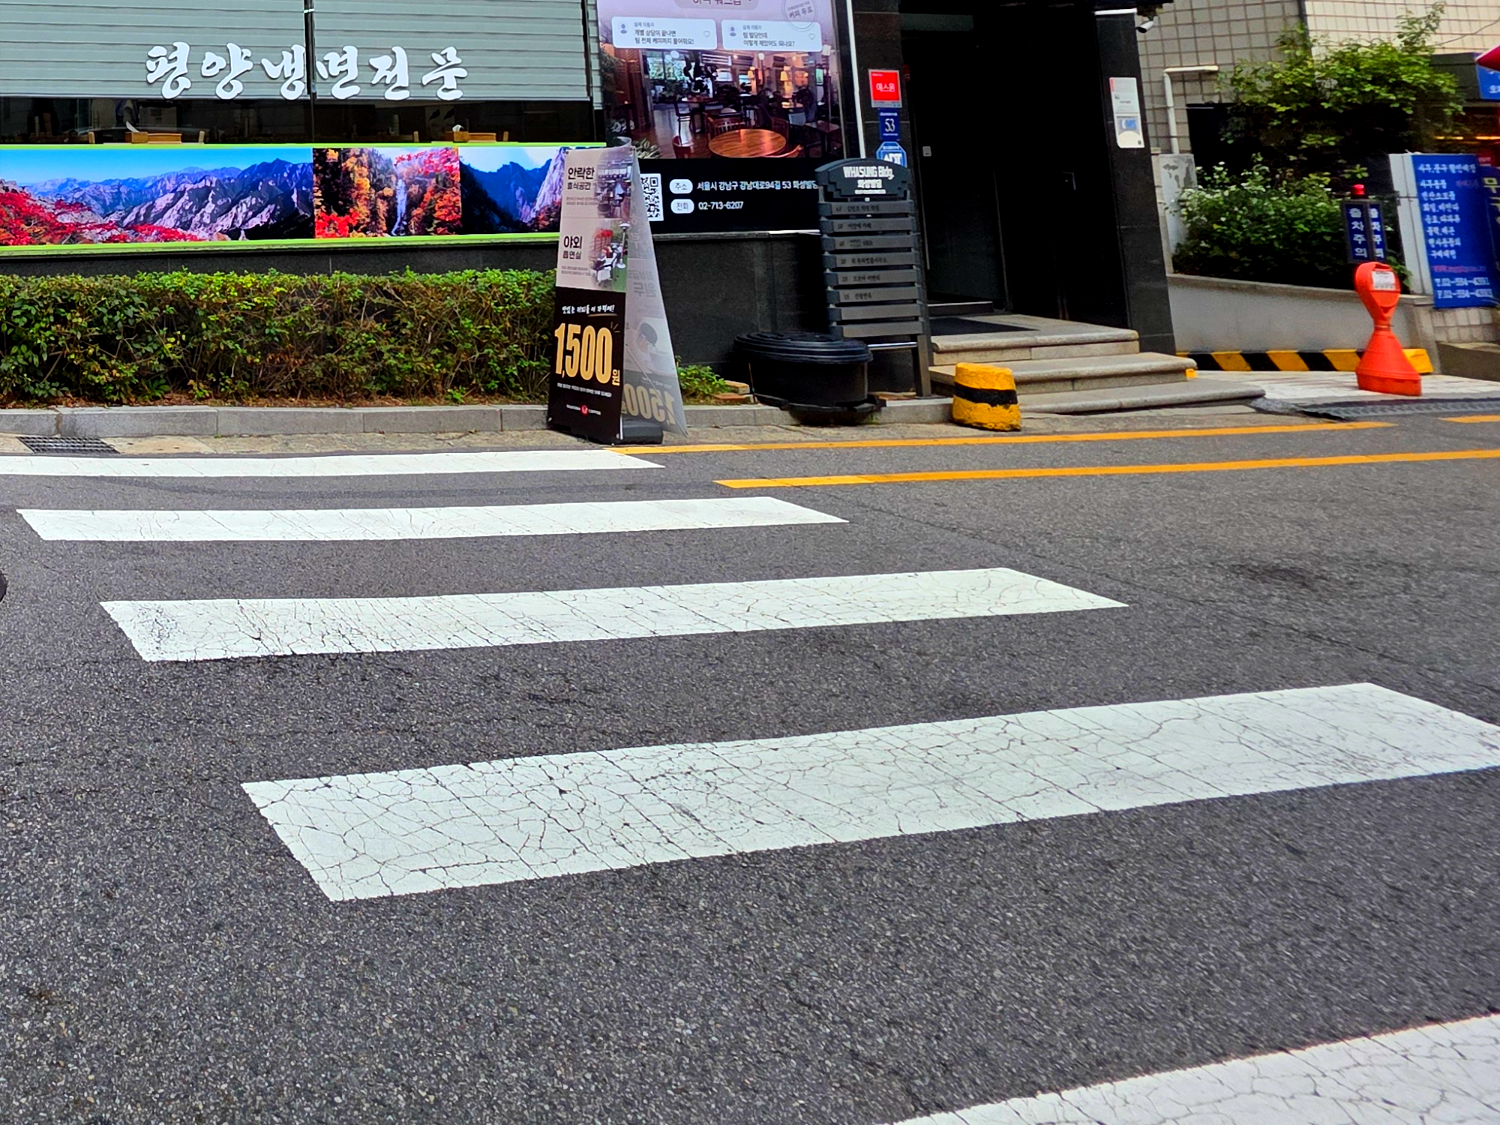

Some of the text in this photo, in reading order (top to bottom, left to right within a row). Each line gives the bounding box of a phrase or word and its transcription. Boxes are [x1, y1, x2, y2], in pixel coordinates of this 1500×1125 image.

[145, 41, 469, 101] 평양냉면전문
[875, 82, 896, 93] 에스원
[884, 118, 896, 133] 53
[567, 167, 595, 180] 안락한
[842, 166, 878, 178] WHASUNG
[566, 181, 592, 191] 휴식공간
[674, 182, 688, 191] 주소
[696, 181, 718, 191] 서울시
[718, 181, 739, 191] 강남구
[739, 180, 781, 191] 강남대로94길
[781, 180, 792, 190] 53
[676, 202, 689, 211] 전화
[1349, 207, 1368, 259] 출차주의
[563, 235, 583, 249] 야외
[562, 250, 582, 260] 흡연실
